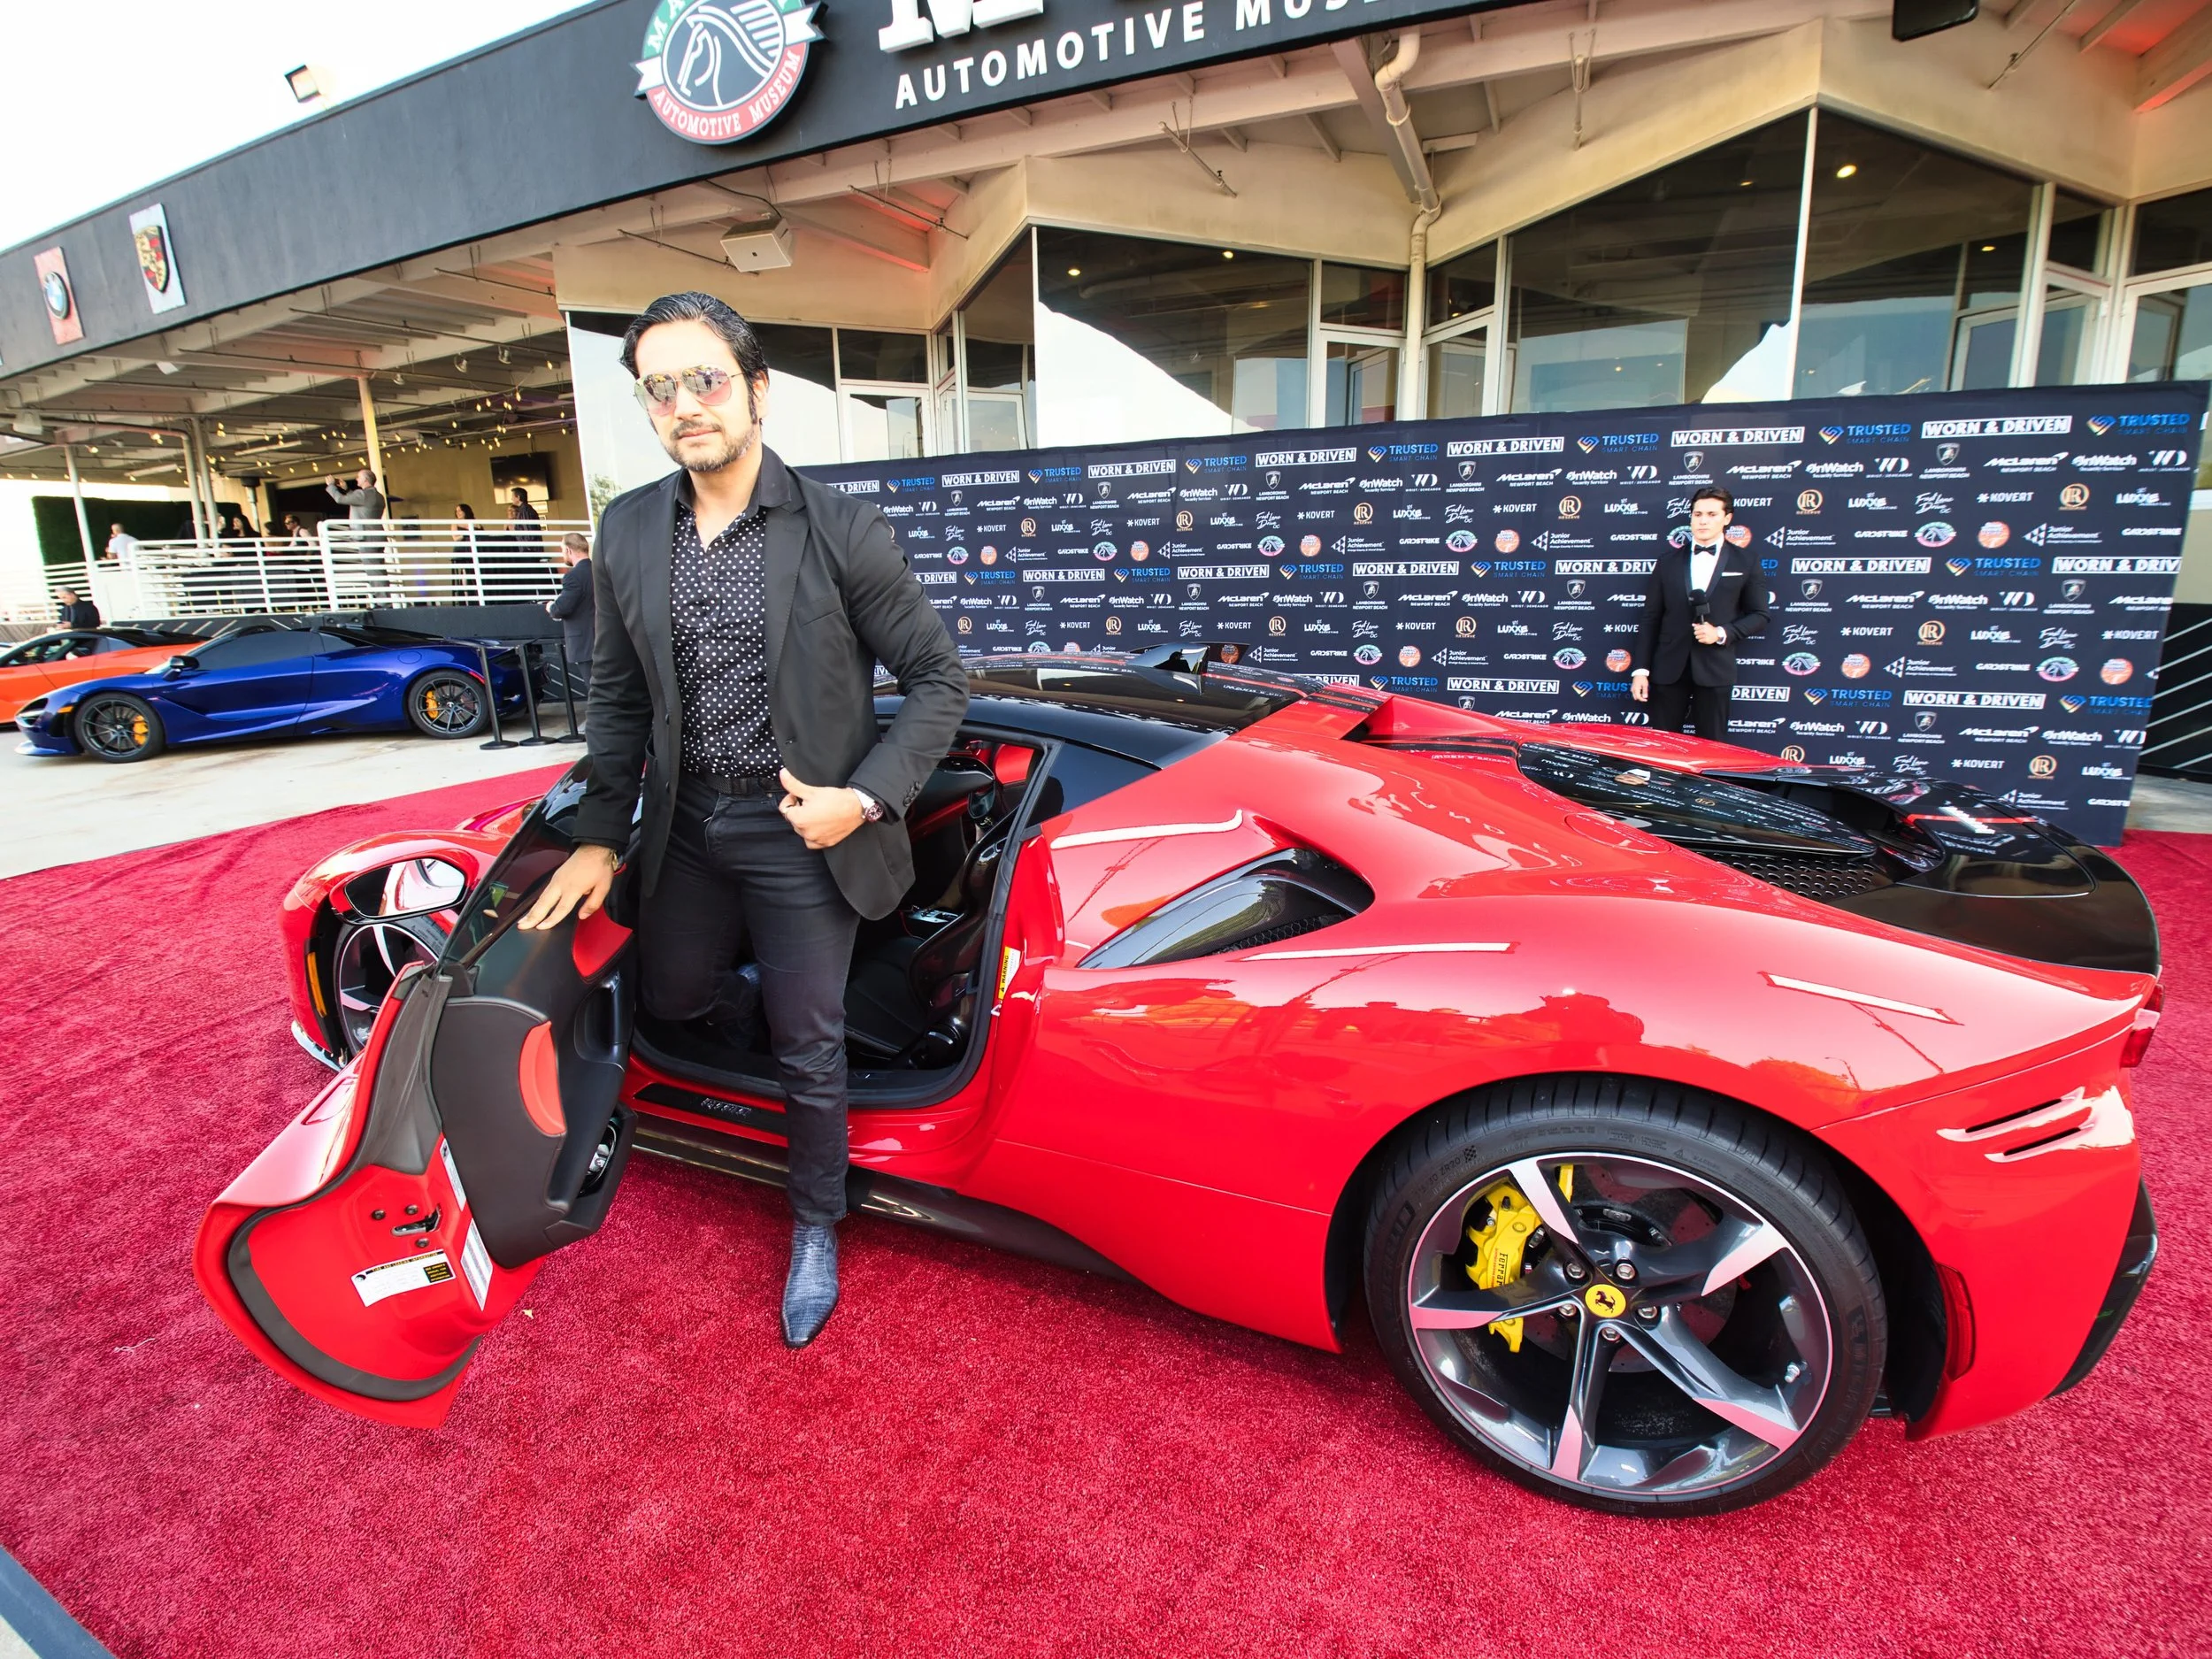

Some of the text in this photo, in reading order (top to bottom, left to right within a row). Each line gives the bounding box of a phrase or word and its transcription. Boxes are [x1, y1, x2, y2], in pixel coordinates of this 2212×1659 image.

[895, 2, 1205, 110] AUTOMOTIVE
[653, 50, 801, 136] AUTOMOTIVE MUSEUM
[2119, 414, 2189, 426] TRUSTED
[1847, 425, 1911, 435] TRUSTED
[1926, 419, 2068, 435] WORN & DRIVEN
[1602, 434, 1659, 445] TRUSTED
[1675, 430, 1800, 444] WORN & DRIVEN
[1389, 444, 1438, 454] TRUSTED
[1451, 440, 1561, 455] WORN & DRIVEN
[1204, 457, 1247, 466] TRUSTED
[1258, 449, 1354, 465] WORN & DRIVEN
[1045, 467, 1081, 476] TRUSTED
[1090, 466, 1122, 477] WORN
[1136, 460, 1173, 473] DRIVEN
[944, 475, 972, 485] WORN
[985, 472, 1018, 481] DRIVEN
[1299, 481, 1348, 490] McLaren
[1734, 498, 1772, 507] KOVERT
[1990, 492, 2033, 503] KOVERT
[1504, 503, 1537, 512] KOVERT
[1356, 563, 1456, 574] WORN & DRIVEN
[1559, 562, 1656, 572] WORN & DRIV
[1795, 560, 1927, 572] WORN & DRIVEN
[1975, 558, 2040, 568] TRUSTED
[2057, 559, 2180, 572] WORN & DRIV
[1025, 571, 1103, 580] WORN & DRIVEN
[1180, 566, 1267, 578] WORN & DRIVEN
[1391, 677, 1438, 686] TRUSTED
[1450, 679, 1556, 692] WORN & DRIVEN
[1732, 688, 1787, 699] DRIVEN
[1832, 689, 1892, 700] TRUSTED
[1908, 693, 2042, 707] WORN & DRIVEN
[1497, 1253, 1508, 1286] Ferrar
